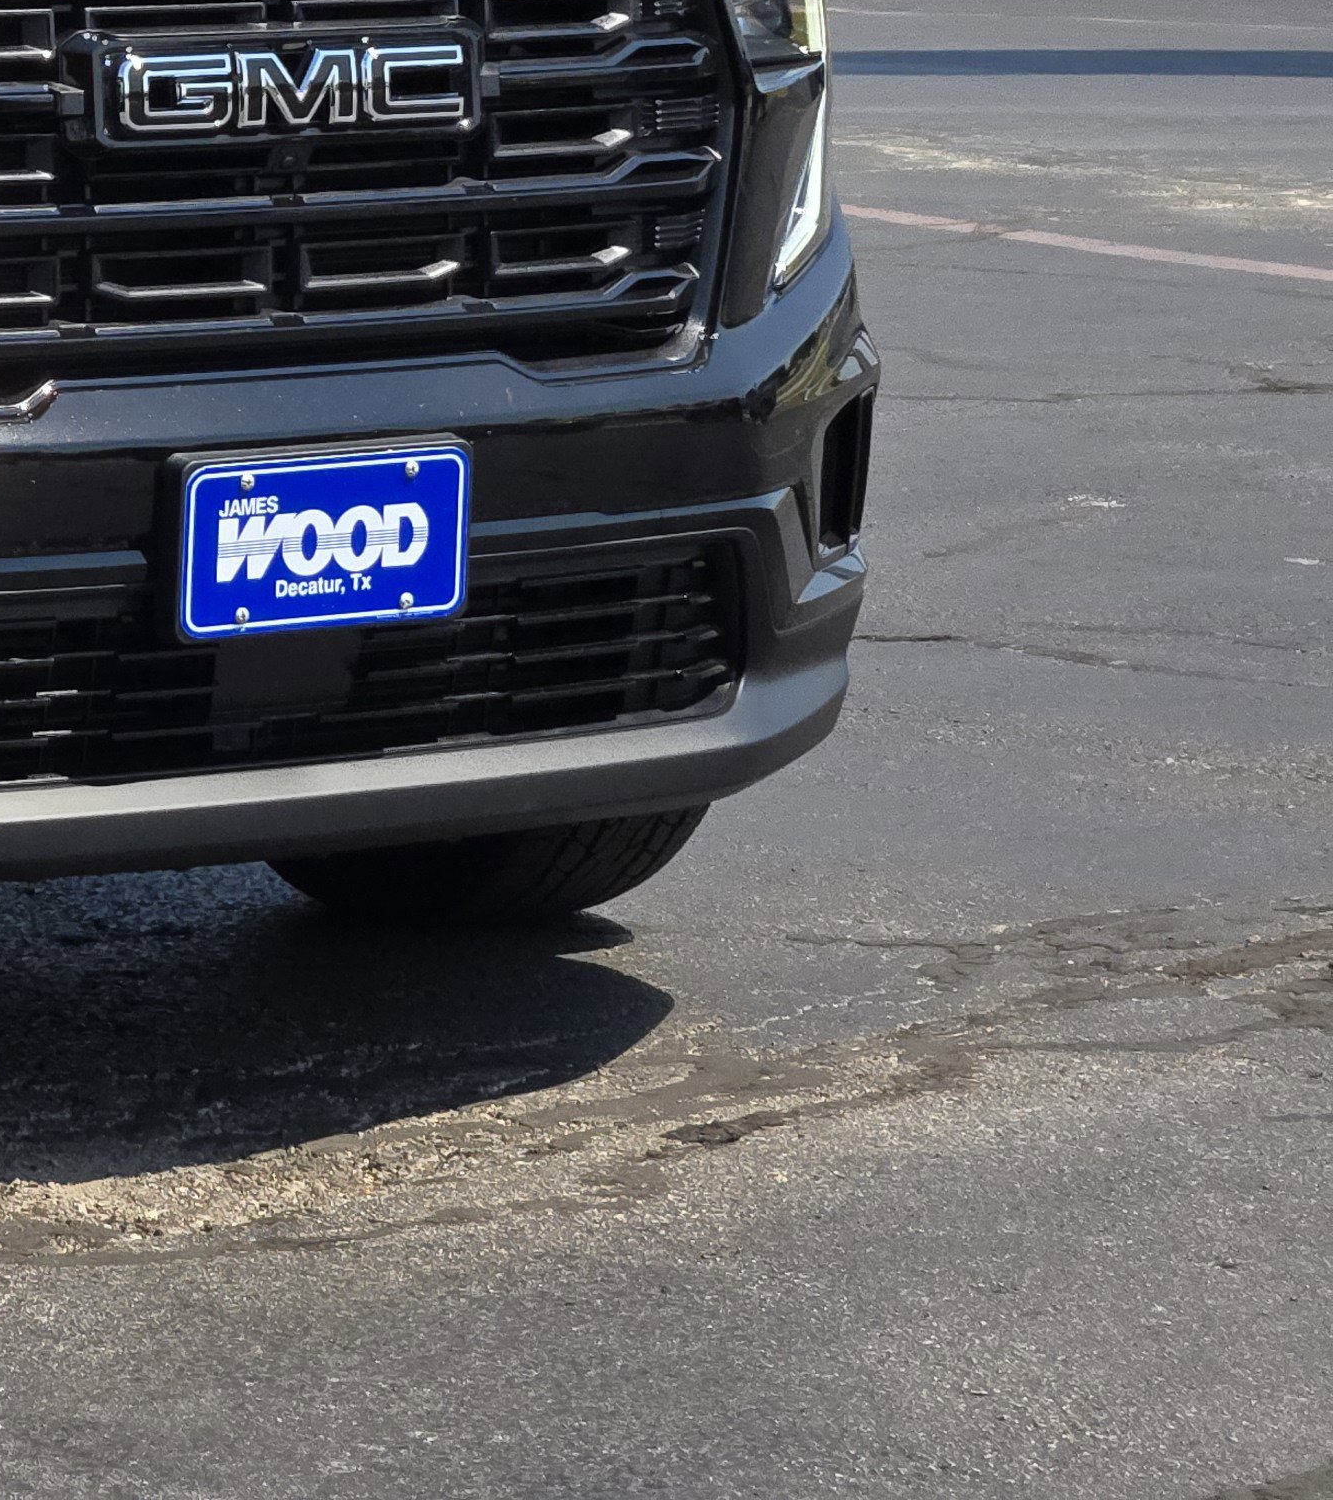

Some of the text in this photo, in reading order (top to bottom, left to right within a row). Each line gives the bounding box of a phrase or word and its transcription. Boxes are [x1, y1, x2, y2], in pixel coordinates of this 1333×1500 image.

[118, 44, 465, 131] GMC
[218, 495, 279, 518] JAMES
[216, 502, 429, 583] WOOD
[275, 573, 372, 598] Decatur, Tx
